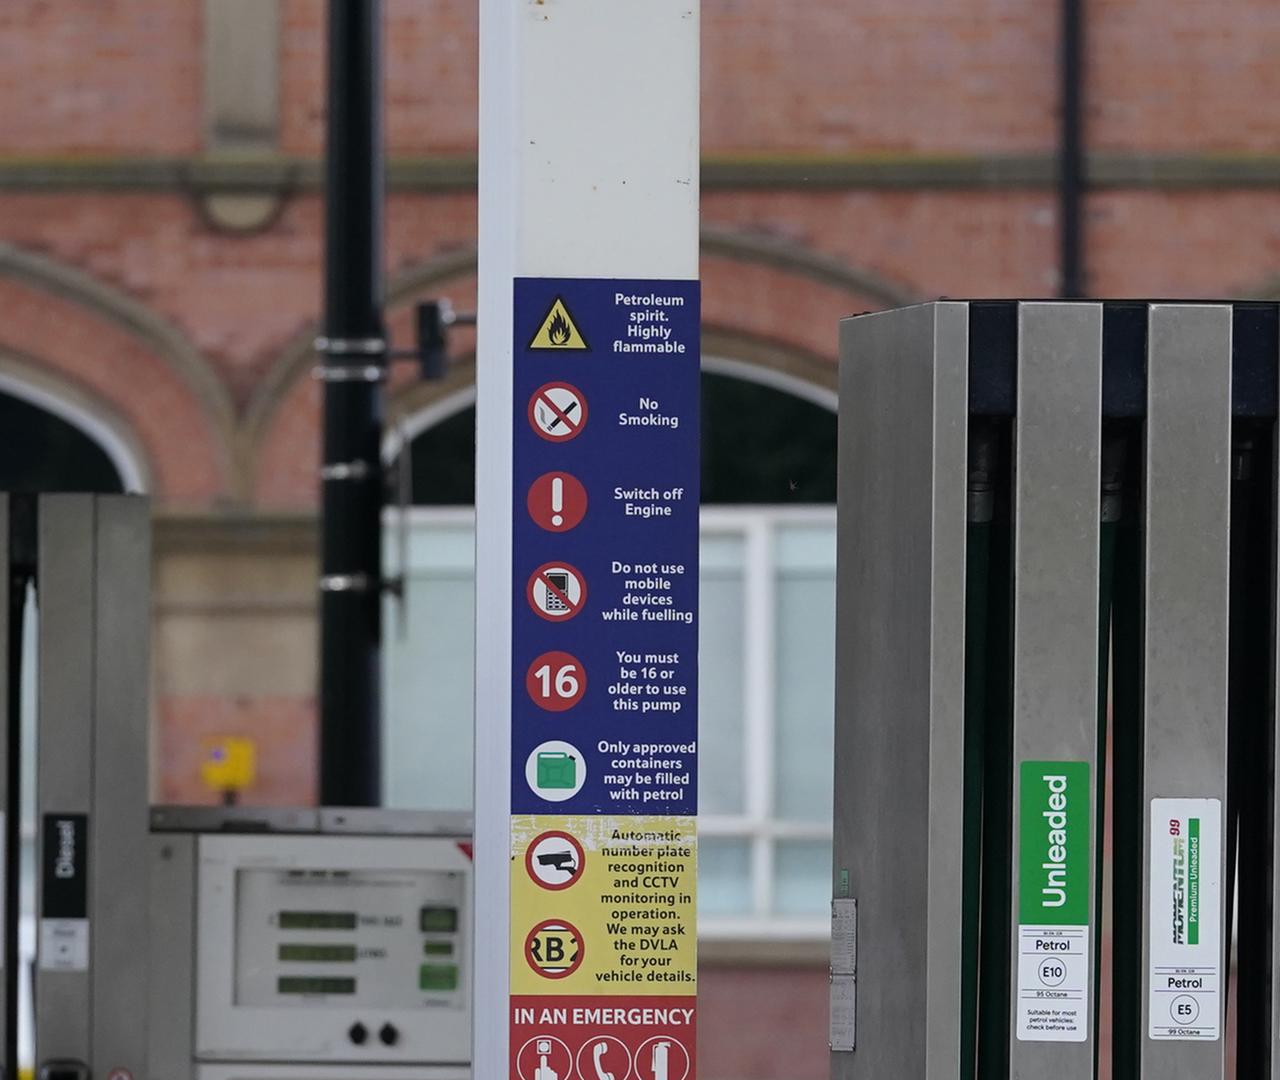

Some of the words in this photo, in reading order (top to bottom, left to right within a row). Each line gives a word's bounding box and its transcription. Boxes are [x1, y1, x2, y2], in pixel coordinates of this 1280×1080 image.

[615, 293, 684, 306] Petroleum
[630, 309, 669, 324] spirit.
[628, 325, 672, 340] Highly
[613, 338, 685, 353] flammable
[640, 398, 658, 410] No
[619, 413, 678, 428] Smoking
[614, 487, 659, 500] Switch
[663, 488, 684, 500] off
[625, 503, 672, 518] Engine
[612, 561, 631, 574] Do
[635, 563, 658, 574] not
[661, 565, 684, 574] use
[625, 577, 671, 589] mobile
[623, 593, 673, 605] devices
[602, 608, 638, 620] while
[642, 608, 693, 624] fuelling
[616, 651, 641, 663] You
[645, 653, 679, 664] must
[621, 667, 637, 679] be
[641, 667, 657, 679] 16
[660, 670, 675, 679] or
[534, 665, 578, 698] 16
[608, 682, 643, 695] older
[645, 684, 660, 695] to
[663, 686, 687, 695] use
[613, 698, 639, 710] this
[642, 701, 681, 713] pump
[1170, 819, 1180, 836] 99
[54, 817, 77, 881] Diesel
[1042, 776, 1067, 907] Unleaded
[1189, 837, 1199, 880] Unleaded
[1189, 881, 1198, 922] Premium
[606, 923, 627, 935] We
[631, 926, 660, 938] may
[662, 923, 685, 935] ask
[614, 939, 636, 950] the
[640, 939, 678, 950] DVLA
[1036, 939, 1070, 951] Petrol
[620, 954, 639, 966] for
[641, 957, 672, 969] your
[595, 970, 643, 982] vehicle
[646, 970, 695, 982] details.
[1042, 966, 1063, 978] E10
[1168, 977, 1202, 988] Petrol
[515, 1008, 534, 1024] IN
[539, 1008, 567, 1024] AN
[573, 1008, 694, 1025] EMERGENCY
[1178, 1004, 1192, 1015] E5
